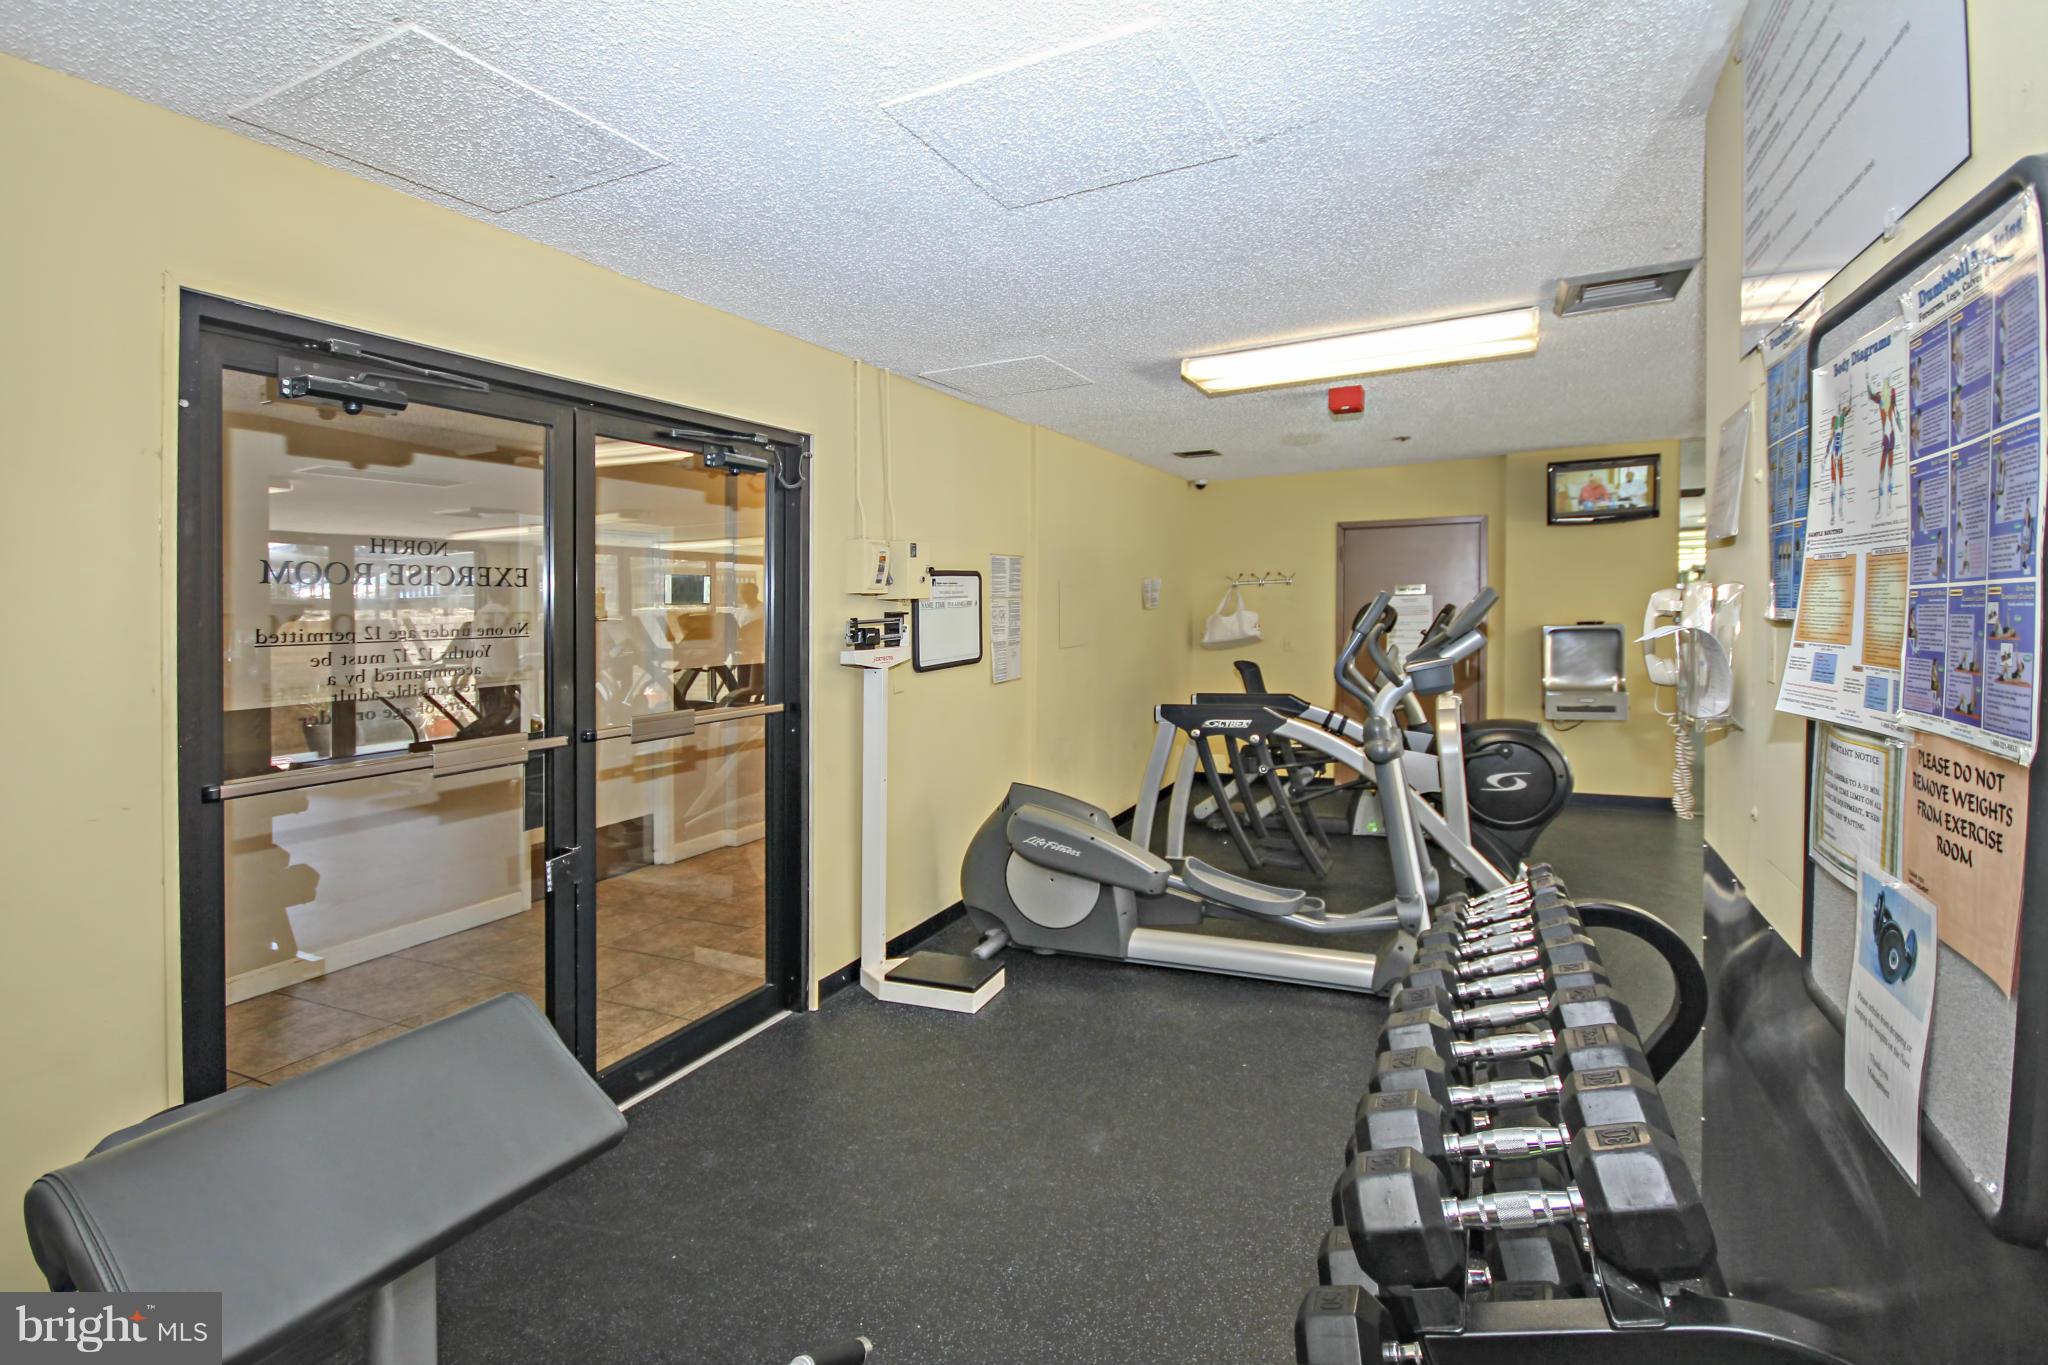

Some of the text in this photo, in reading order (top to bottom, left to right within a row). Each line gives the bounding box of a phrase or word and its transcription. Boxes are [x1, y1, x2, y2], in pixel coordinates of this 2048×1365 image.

[1918, 257, 1970, 308] Dumbbell
[1833, 335, 1892, 378] Body Diagrams
[1830, 741, 1880, 765] RTANT NOTICE
[1917, 749, 2006, 792] PLEASE DO NOT
[1849, 790, 1865, 802] LIMIT
[1913, 771, 2013, 827] REMOVE WEIGHTS
[1917, 799, 2004, 853] FROM EXERCISE
[1022, 836, 1081, 857] Life Fitness
[1936, 835, 1973, 868] ROOM
[1601, 1127, 1634, 1147] 30
